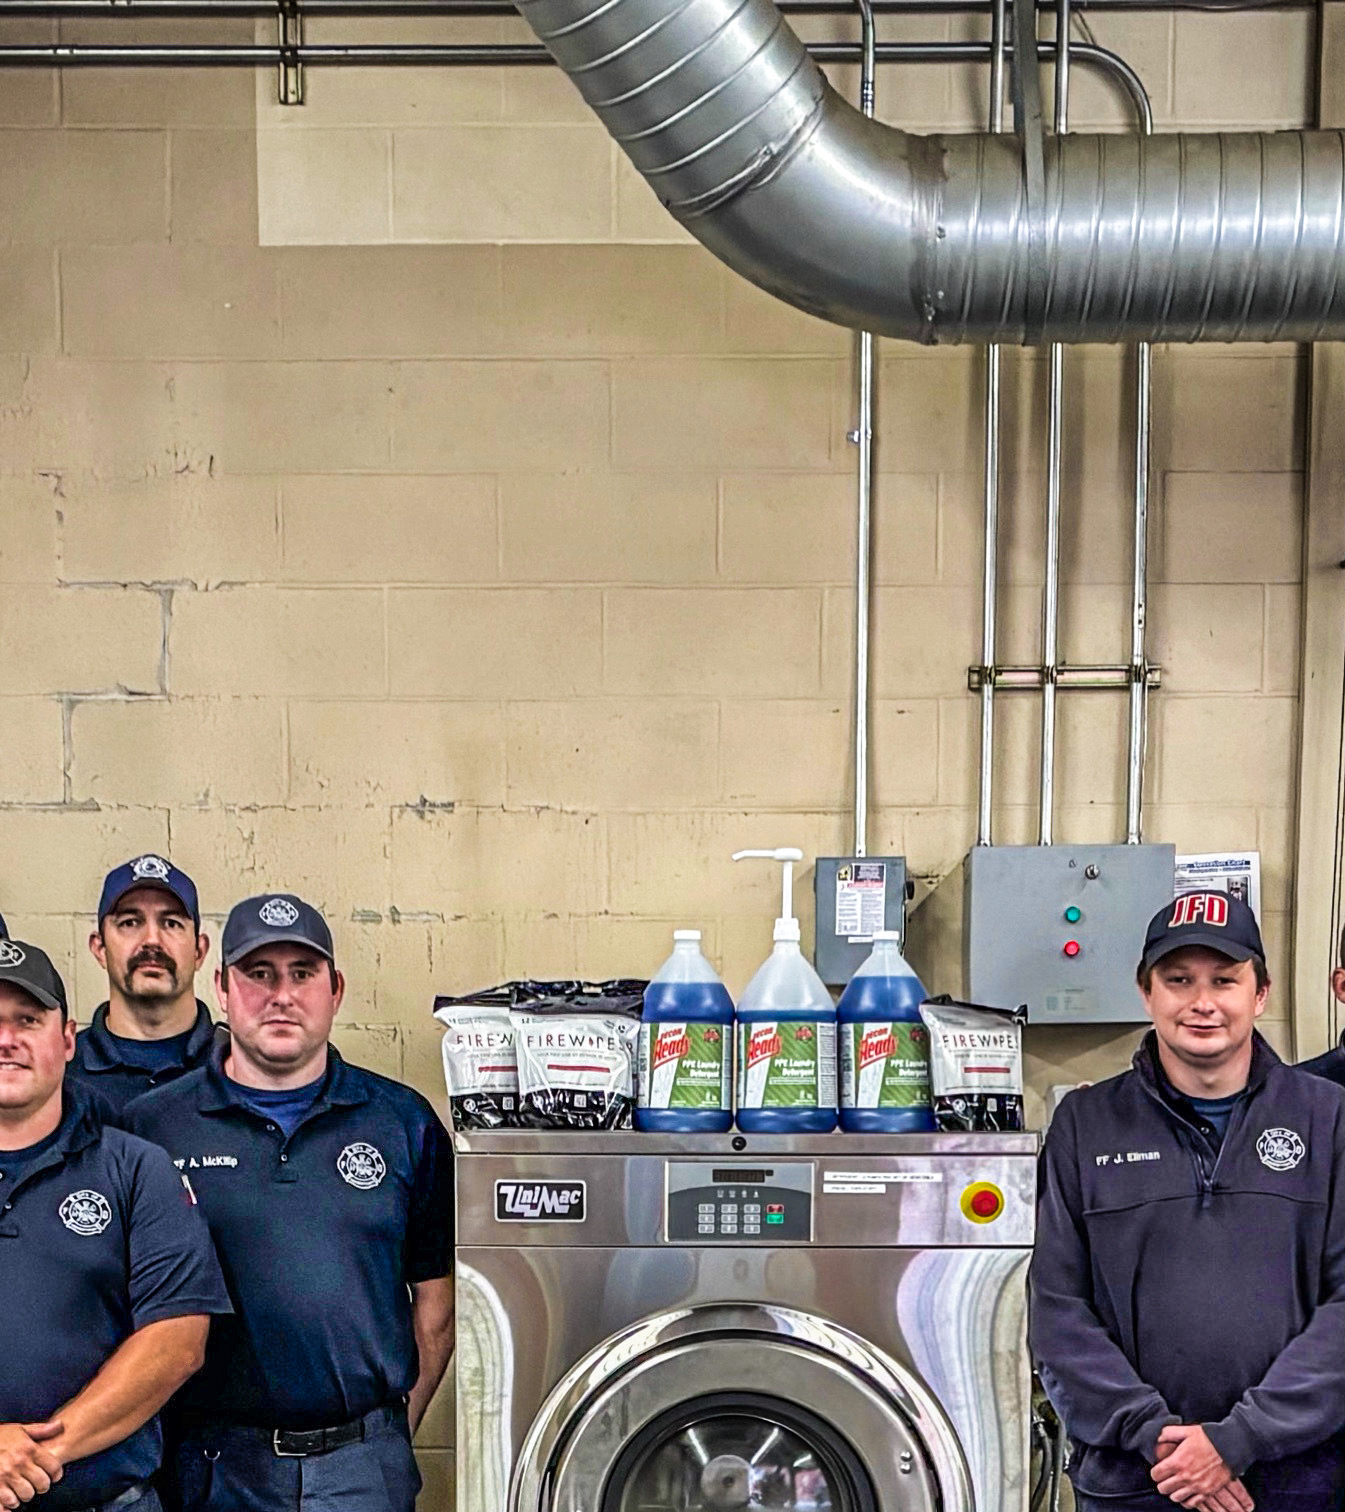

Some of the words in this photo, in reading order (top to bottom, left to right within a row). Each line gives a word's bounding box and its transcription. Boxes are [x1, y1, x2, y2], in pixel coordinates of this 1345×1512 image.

[1168, 894, 1229, 928] JFD
[789, 1059, 815, 1070] Laundry
[189, 1157, 200, 1168] A.
[1096, 1155, 1110, 1167] FF
[1114, 1153, 1124, 1164] J.
[499, 1185, 581, 1217] UniMac
